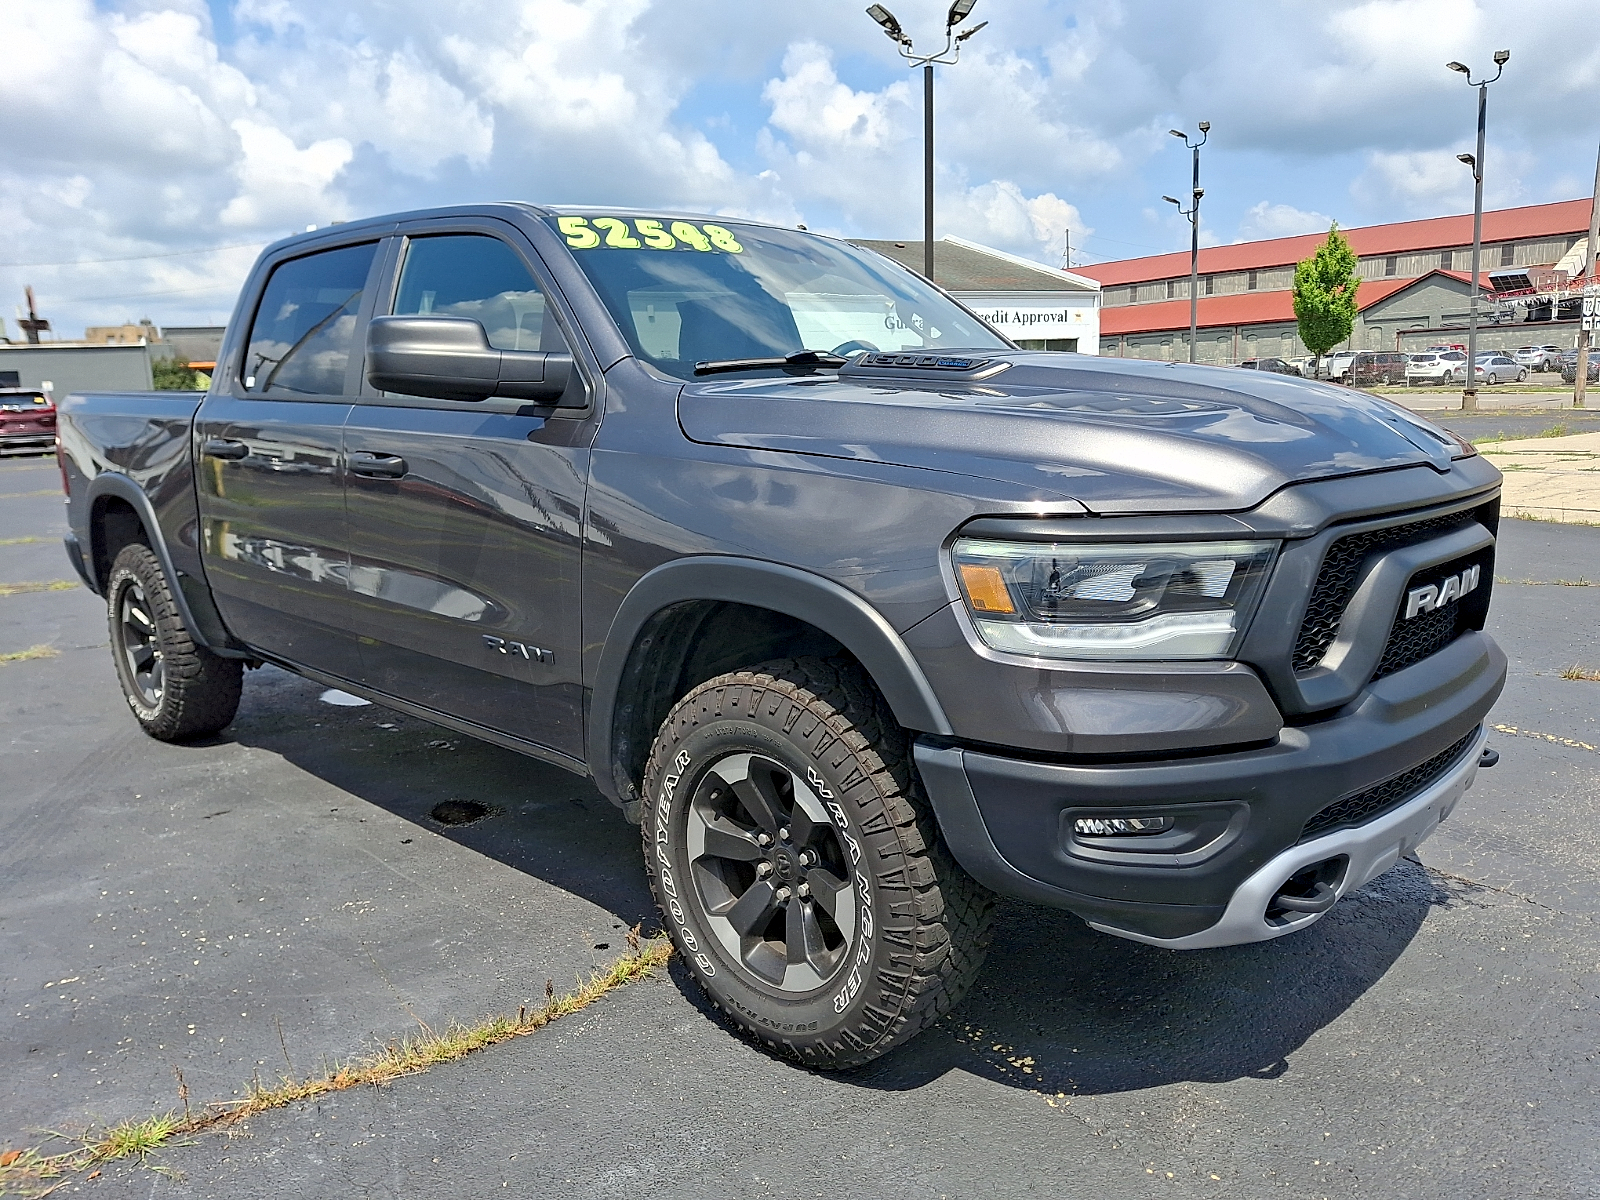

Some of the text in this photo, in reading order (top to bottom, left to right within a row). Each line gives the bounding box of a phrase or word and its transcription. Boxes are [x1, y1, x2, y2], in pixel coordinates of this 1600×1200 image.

[557, 216, 744, 254] 52548
[1012, 310, 1068, 326] Approval
[866, 353, 938, 367] 1500
[1405, 564, 1480, 619] RAM
[482, 634, 555, 664] RAM
[656, 750, 716, 977] GOODYEAR
[807, 765, 874, 1014] WRANGLER
